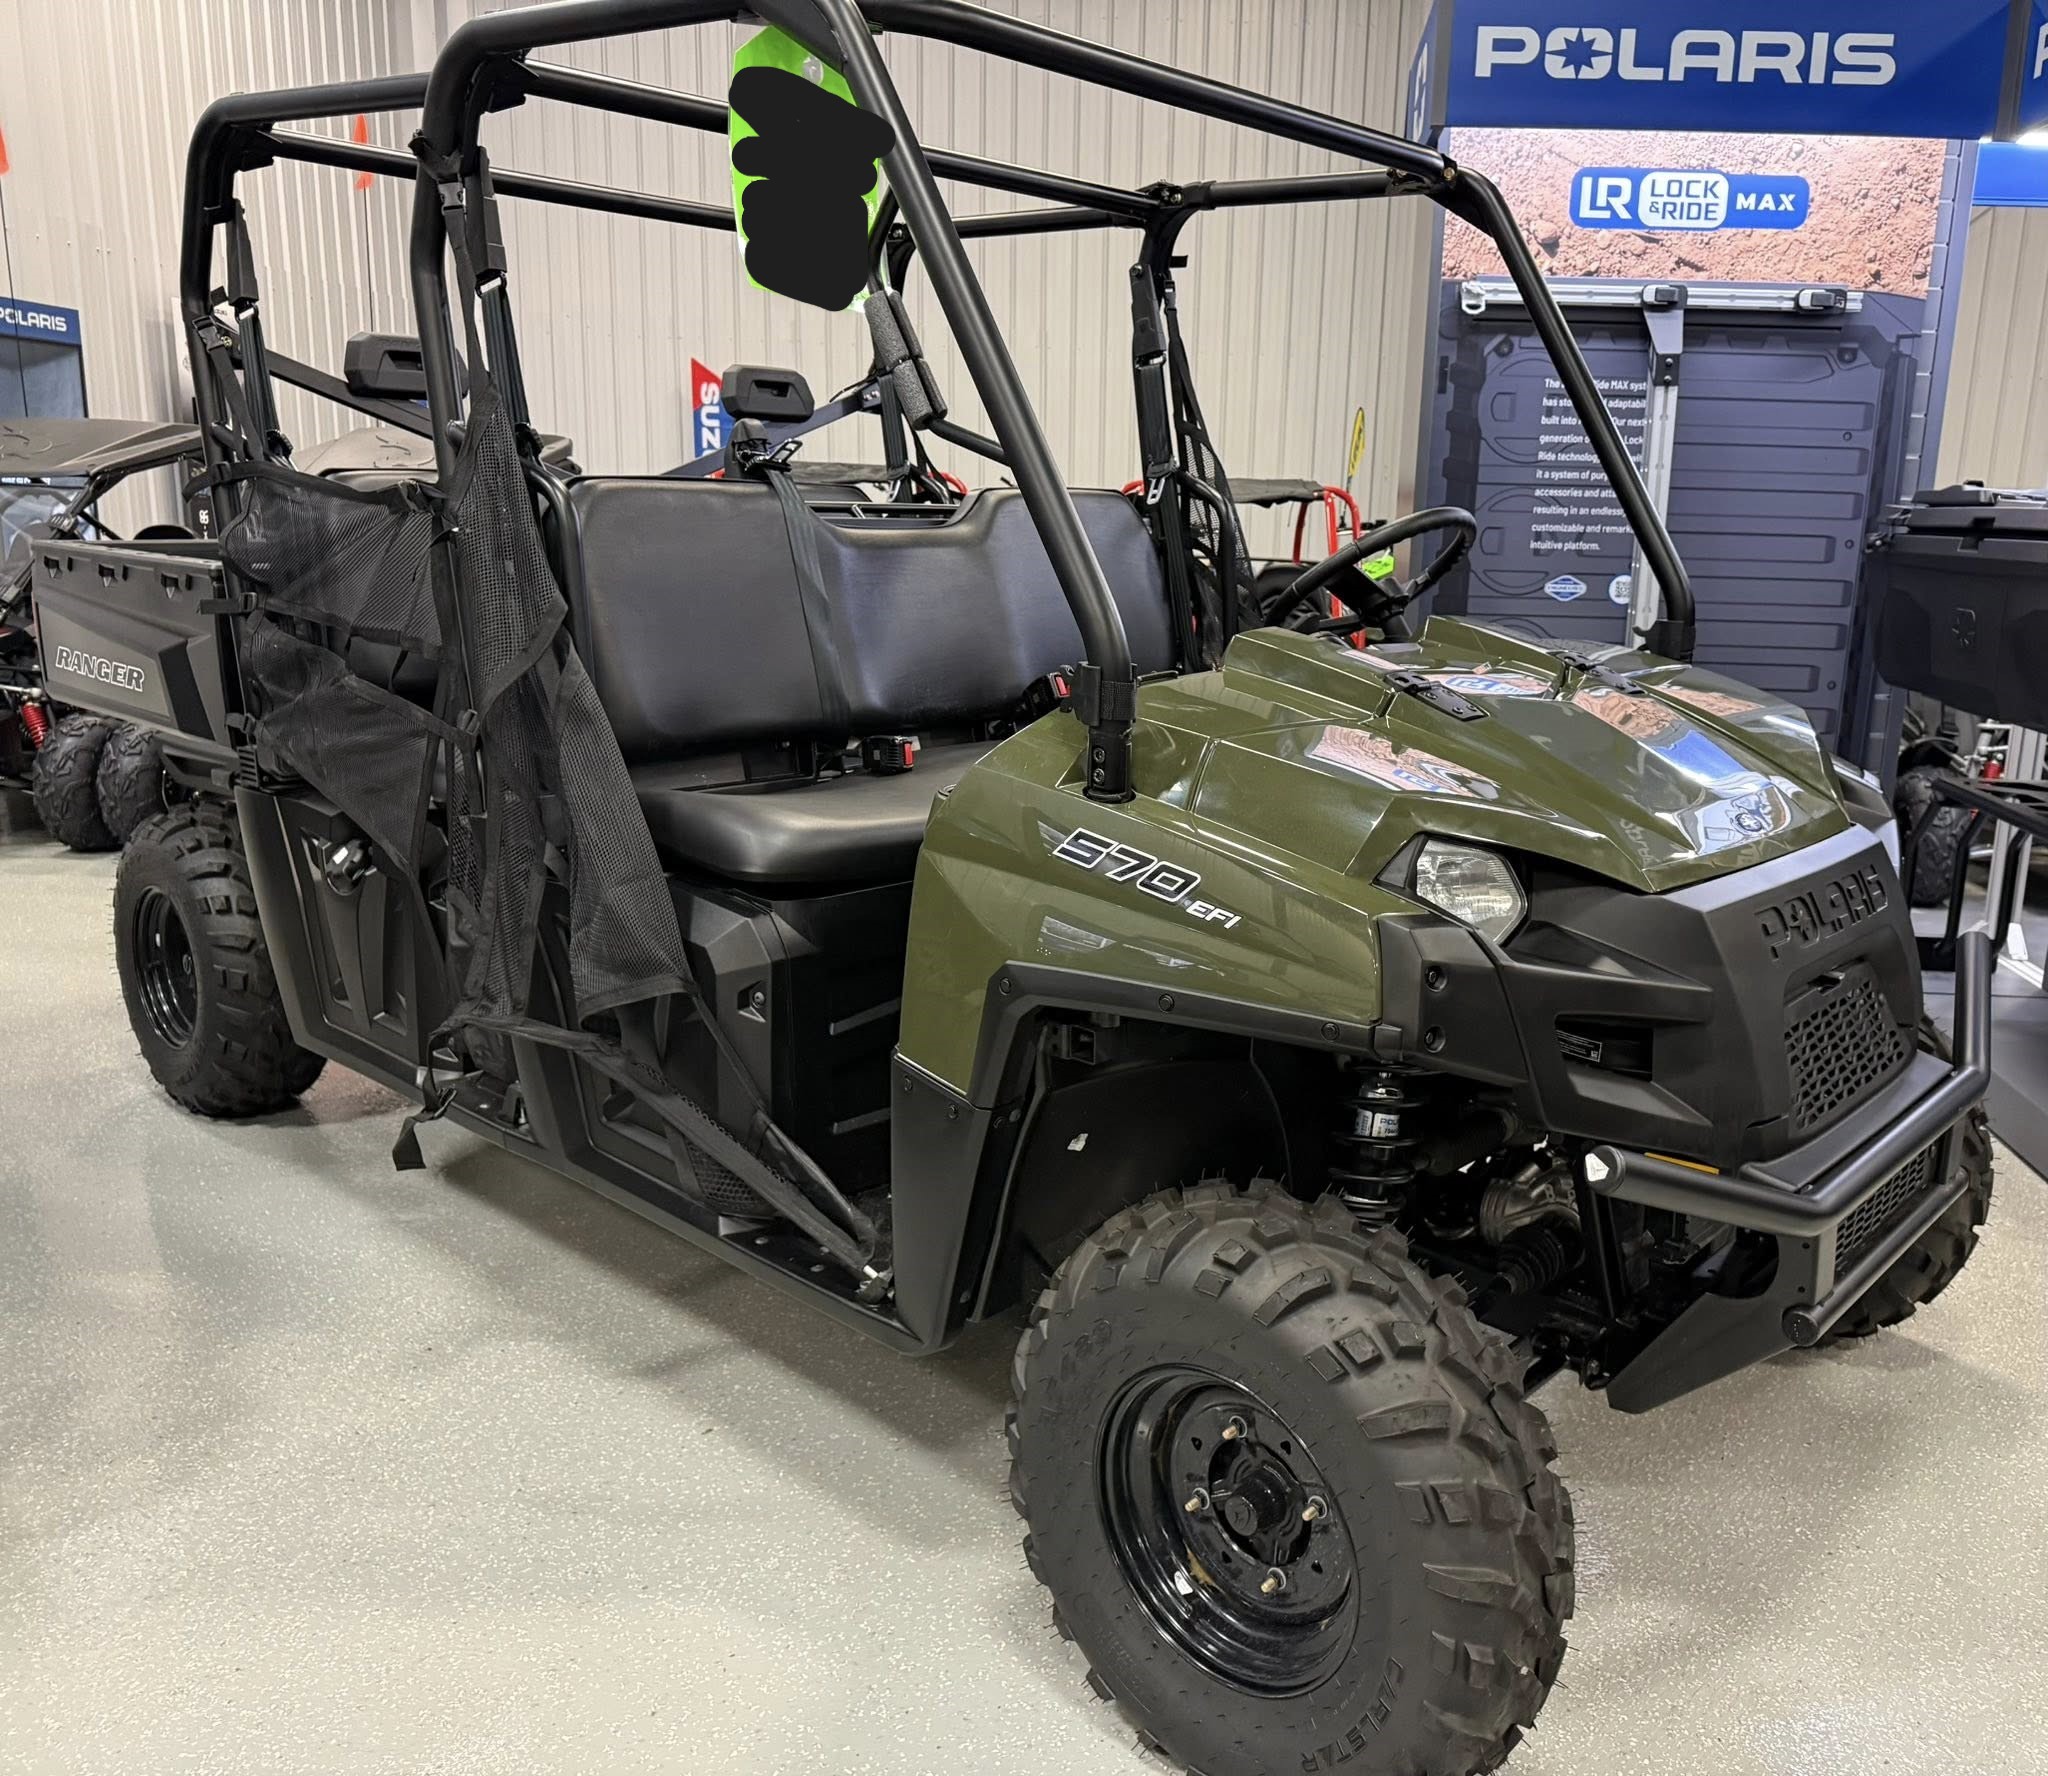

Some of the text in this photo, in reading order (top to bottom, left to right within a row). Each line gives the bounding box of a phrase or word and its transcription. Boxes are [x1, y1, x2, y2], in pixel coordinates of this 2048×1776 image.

[1475, 26, 1898, 86] POLARIS
[1650, 178, 1720, 199] LOCK
[1735, 193, 1796, 212] MAX
[1648, 201, 1719, 221] &RIDE
[1610, 380, 1628, 390] MAX
[1629, 382, 1647, 392] syst
[1543, 397, 1557, 407] has
[1541, 416, 1559, 425] built
[1561, 416, 1578, 425] into
[1539, 434, 1583, 445] generation
[1537, 452, 1556, 461] Ride
[1536, 469, 1543, 479] it
[1551, 470, 1579, 481] system
[1580, 470, 1589, 479] of
[1534, 487, 1582, 497] accessories
[1583, 488, 1599, 498] and
[1533, 505, 1568, 517] resulting
[1569, 506, 1578, 515] in
[1578, 507, 1589, 515] an
[1531, 523, 1585, 533] customizable
[1585, 524, 1601, 533] and
[1564, 540, 1601, 551] platform.
[55, 645, 145, 693] RANGER
[1052, 827, 1242, 930] 570 EFI
[1753, 864, 1889, 962] POLARIS
